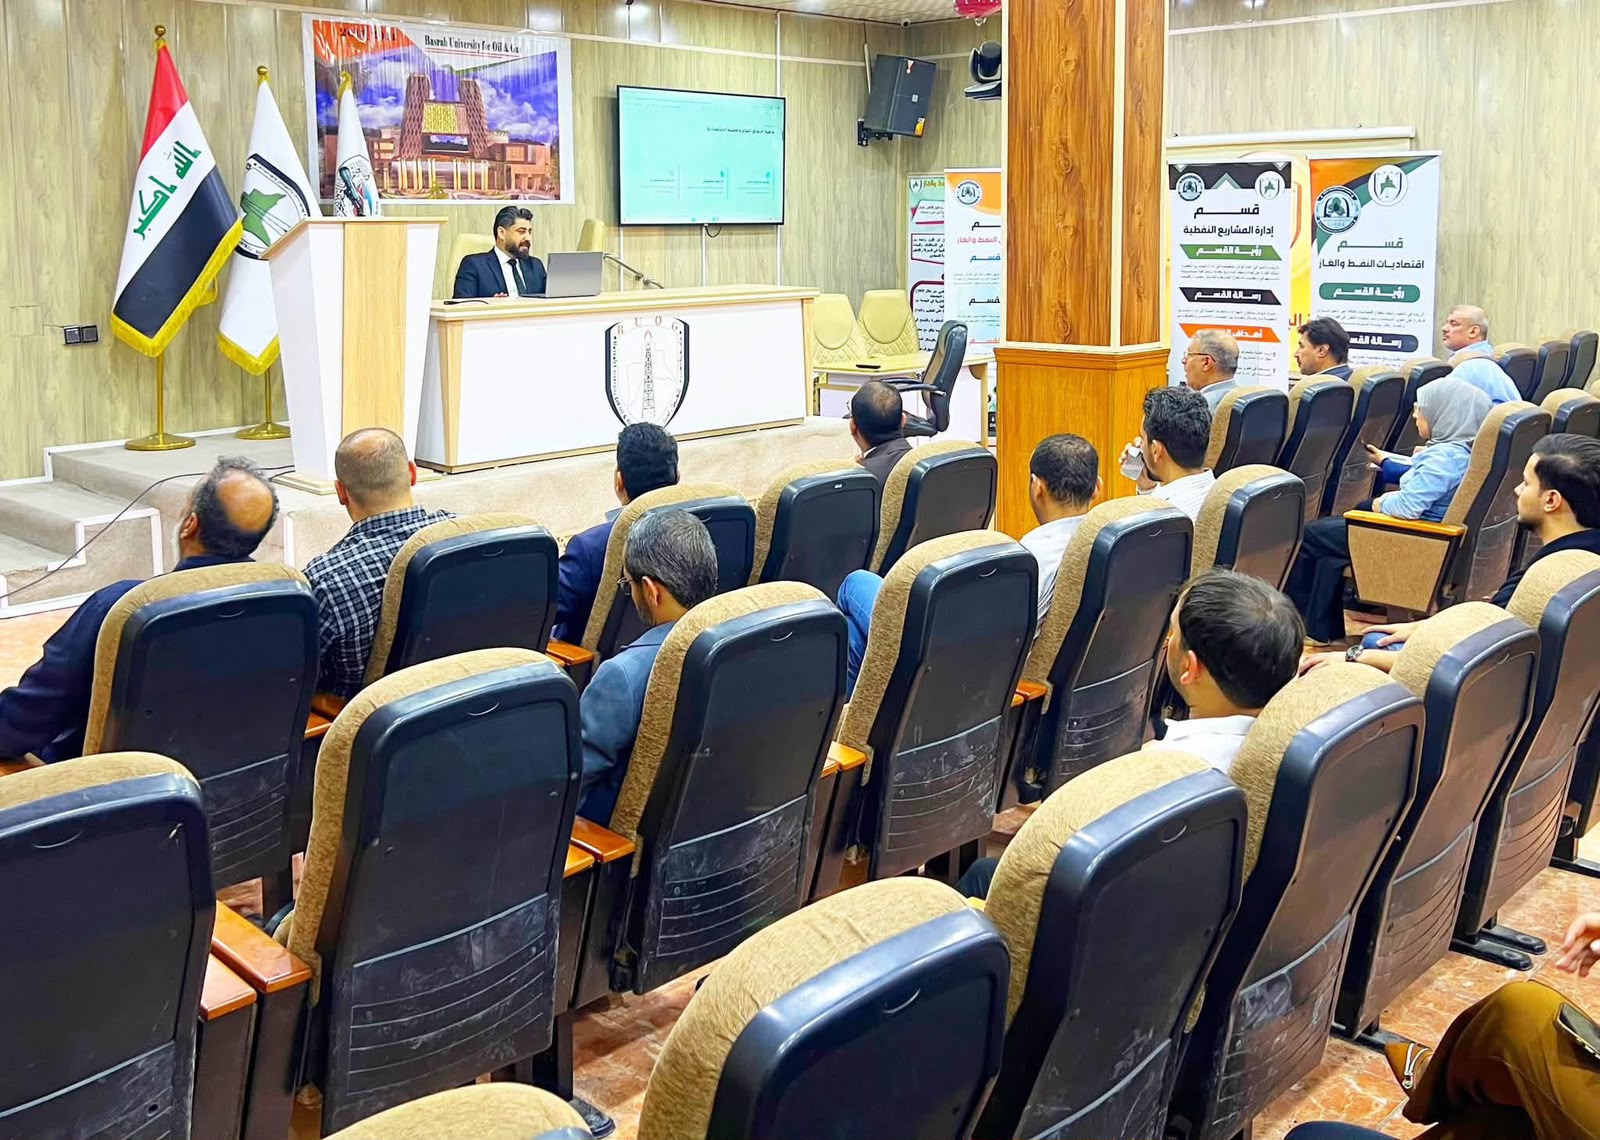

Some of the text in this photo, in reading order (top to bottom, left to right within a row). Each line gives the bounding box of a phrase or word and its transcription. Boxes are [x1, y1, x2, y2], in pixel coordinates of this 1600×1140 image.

[492, 41, 502, 52] Oil
[1193, 203, 1260, 219] قسم
[1183, 225, 1274, 238] إدارة المشاريع النفطية
[1337, 237, 1403, 252] قسم
[1195, 246, 1234, 257] القسم
[1318, 259, 1425, 271] اقتصاديات النفط والغاز
[1194, 290, 1262, 302] رسالة القسم
[1333, 286, 1374, 298] القسم
[1349, 335, 1402, 348] رسالة القس
